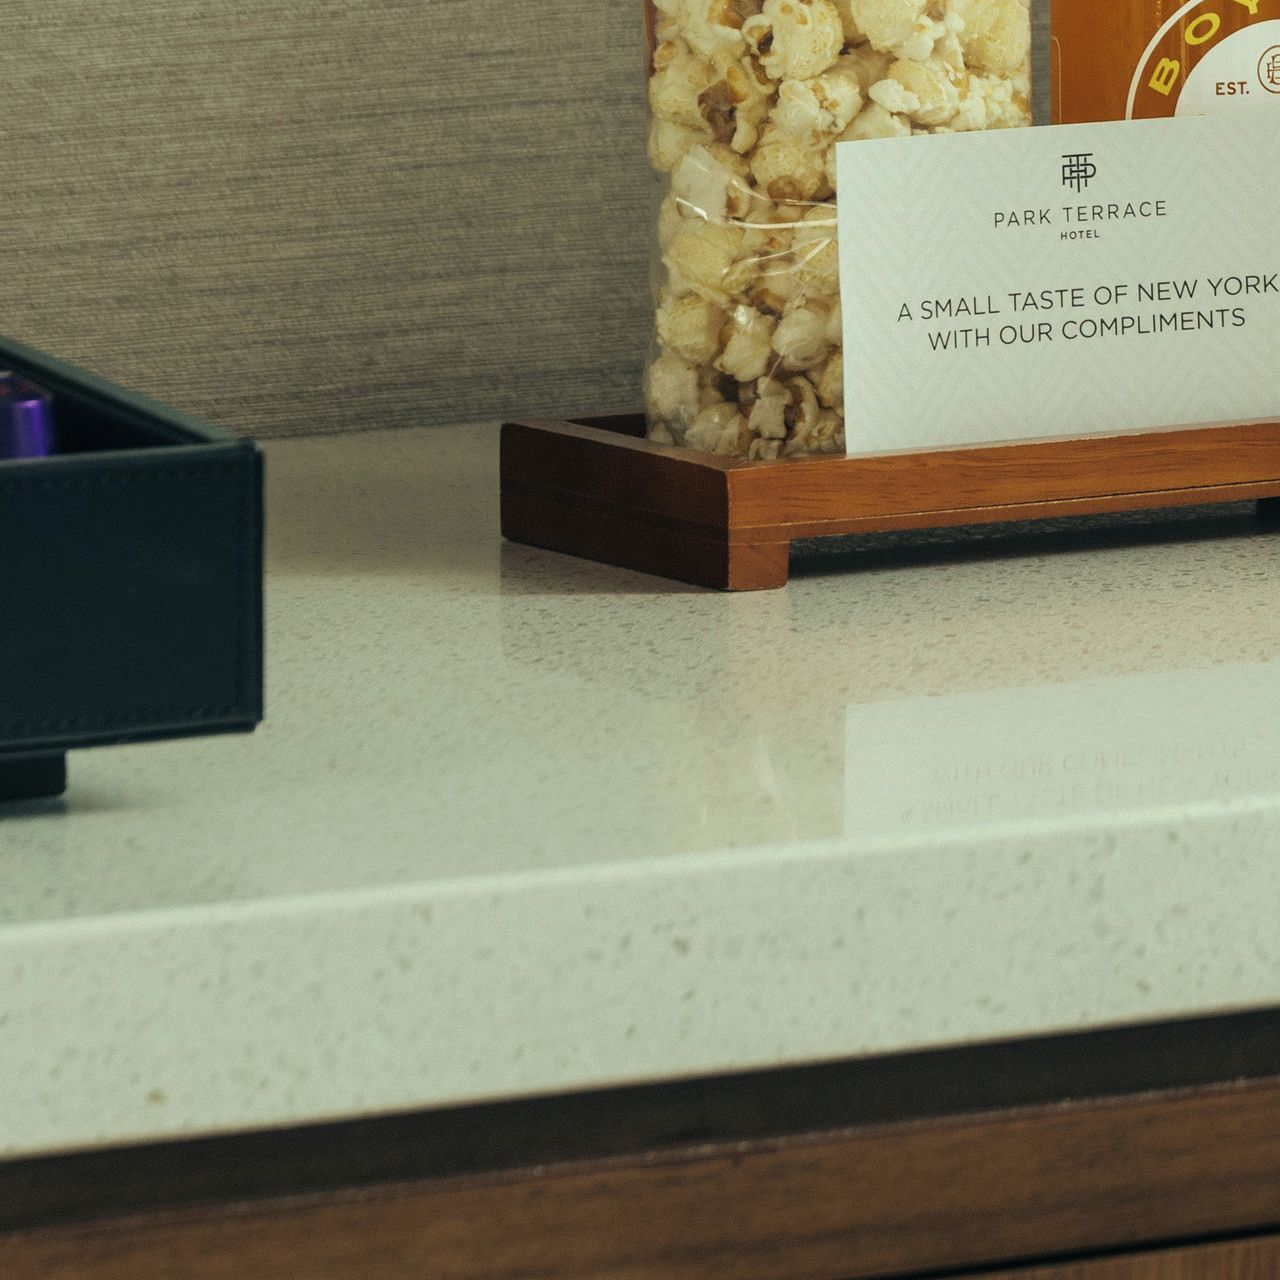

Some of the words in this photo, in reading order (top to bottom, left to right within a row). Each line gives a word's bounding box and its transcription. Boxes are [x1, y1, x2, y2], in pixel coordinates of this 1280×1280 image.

[1214, 81, 1251, 97] EST.
[993, 208, 1053, 228] PARK
[1062, 200, 1168, 223] TERRACE
[1060, 229, 1100, 241] HOTEL
[897, 303, 913, 322] A
[920, 295, 1001, 320] SMALL
[1007, 287, 1086, 313] TASTE
[1093, 284, 1129, 306] OF
[1137, 279, 1199, 303] NEW
[1206, 273, 1280, 297] YORK
[927, 327, 991, 351] WITH
[998, 322, 1053, 345] OUR
[1060, 306, 1247, 340] COMPLIMENTS
